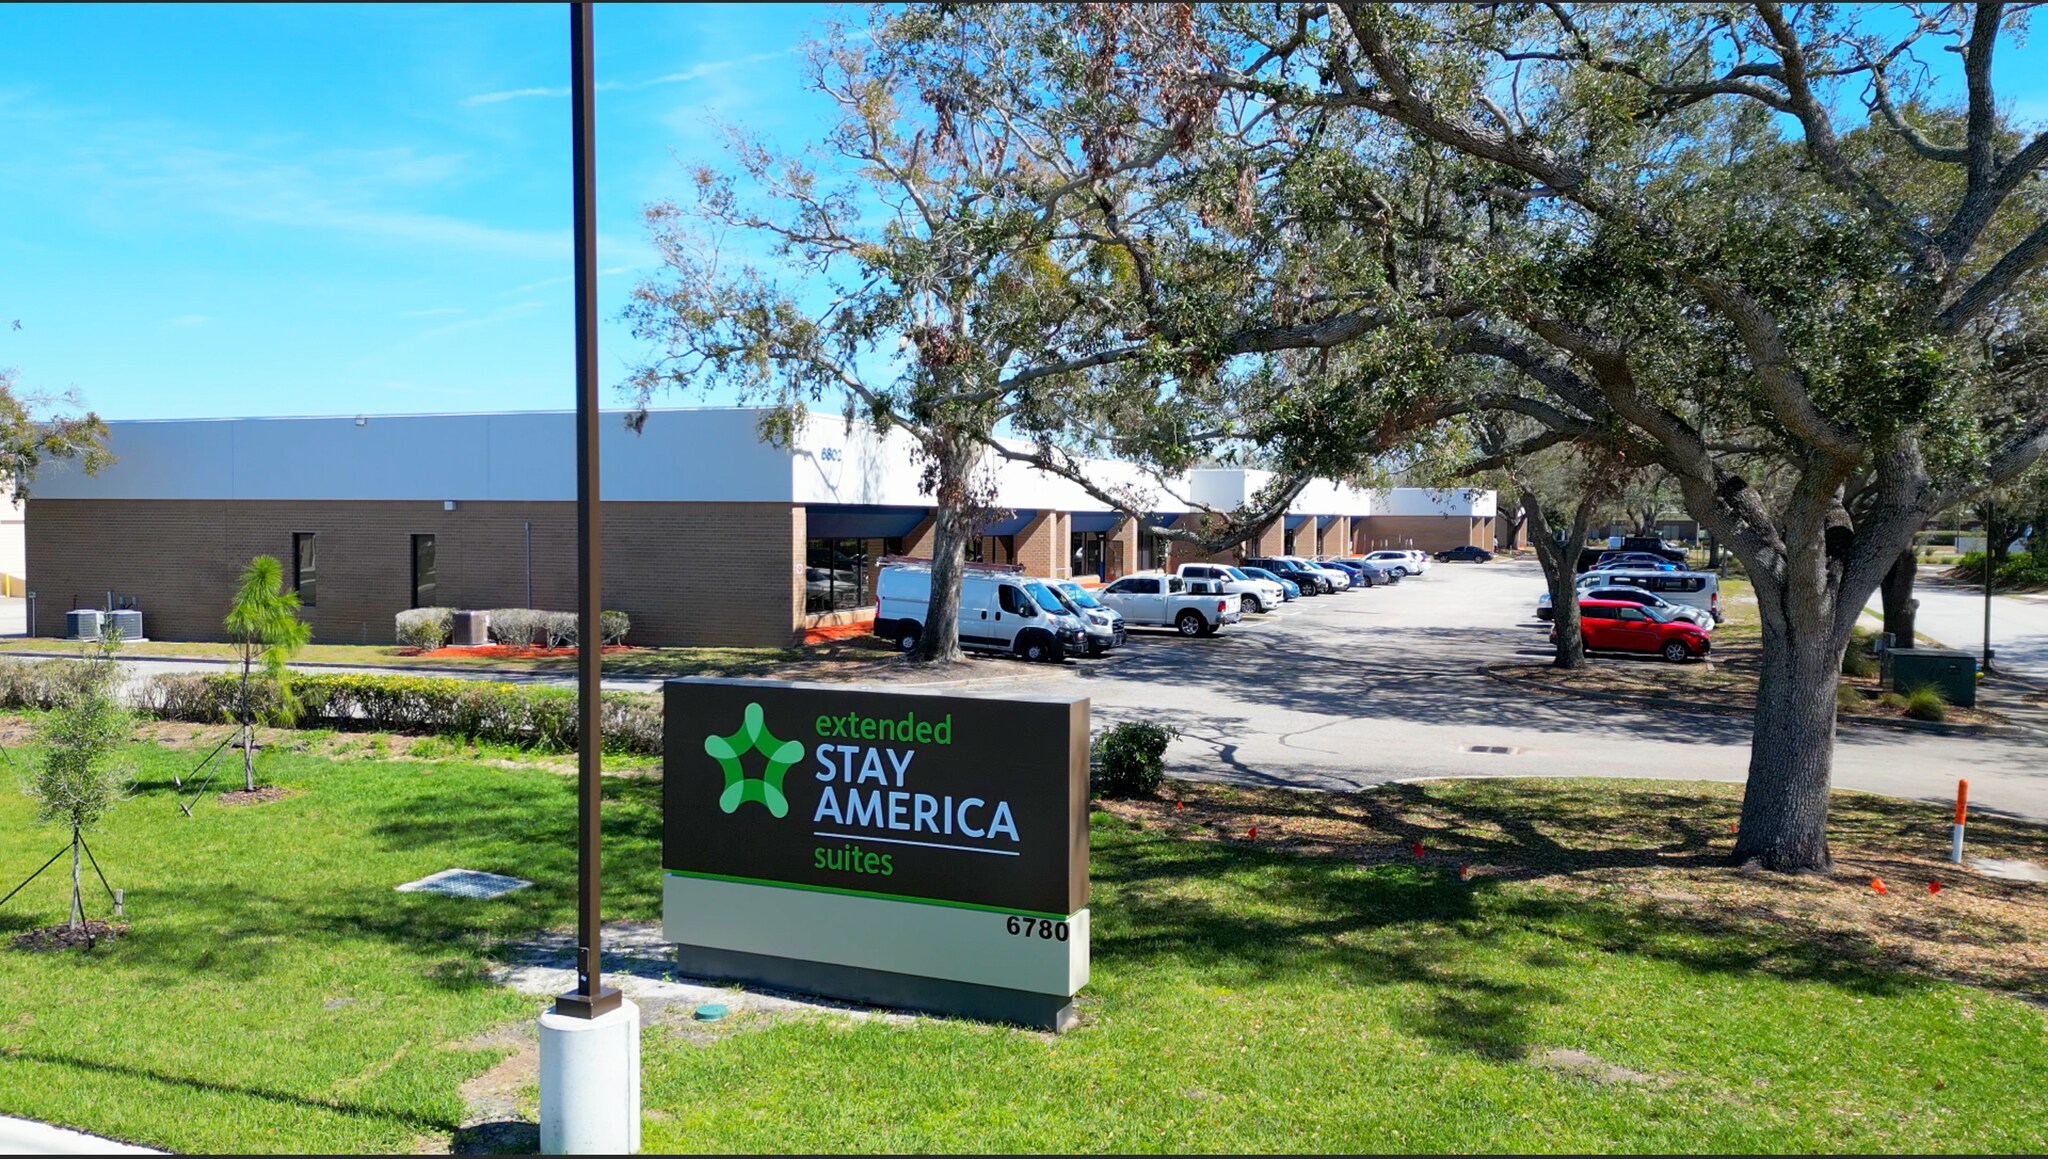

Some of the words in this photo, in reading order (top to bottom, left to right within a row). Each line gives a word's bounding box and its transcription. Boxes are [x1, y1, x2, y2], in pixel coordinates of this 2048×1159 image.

[815, 712, 952, 745] extended
[815, 743, 915, 787] STAY
[813, 786, 1021, 842] AMERICA
[814, 844, 894, 876] suites
[1006, 915, 1069, 942] 6780
